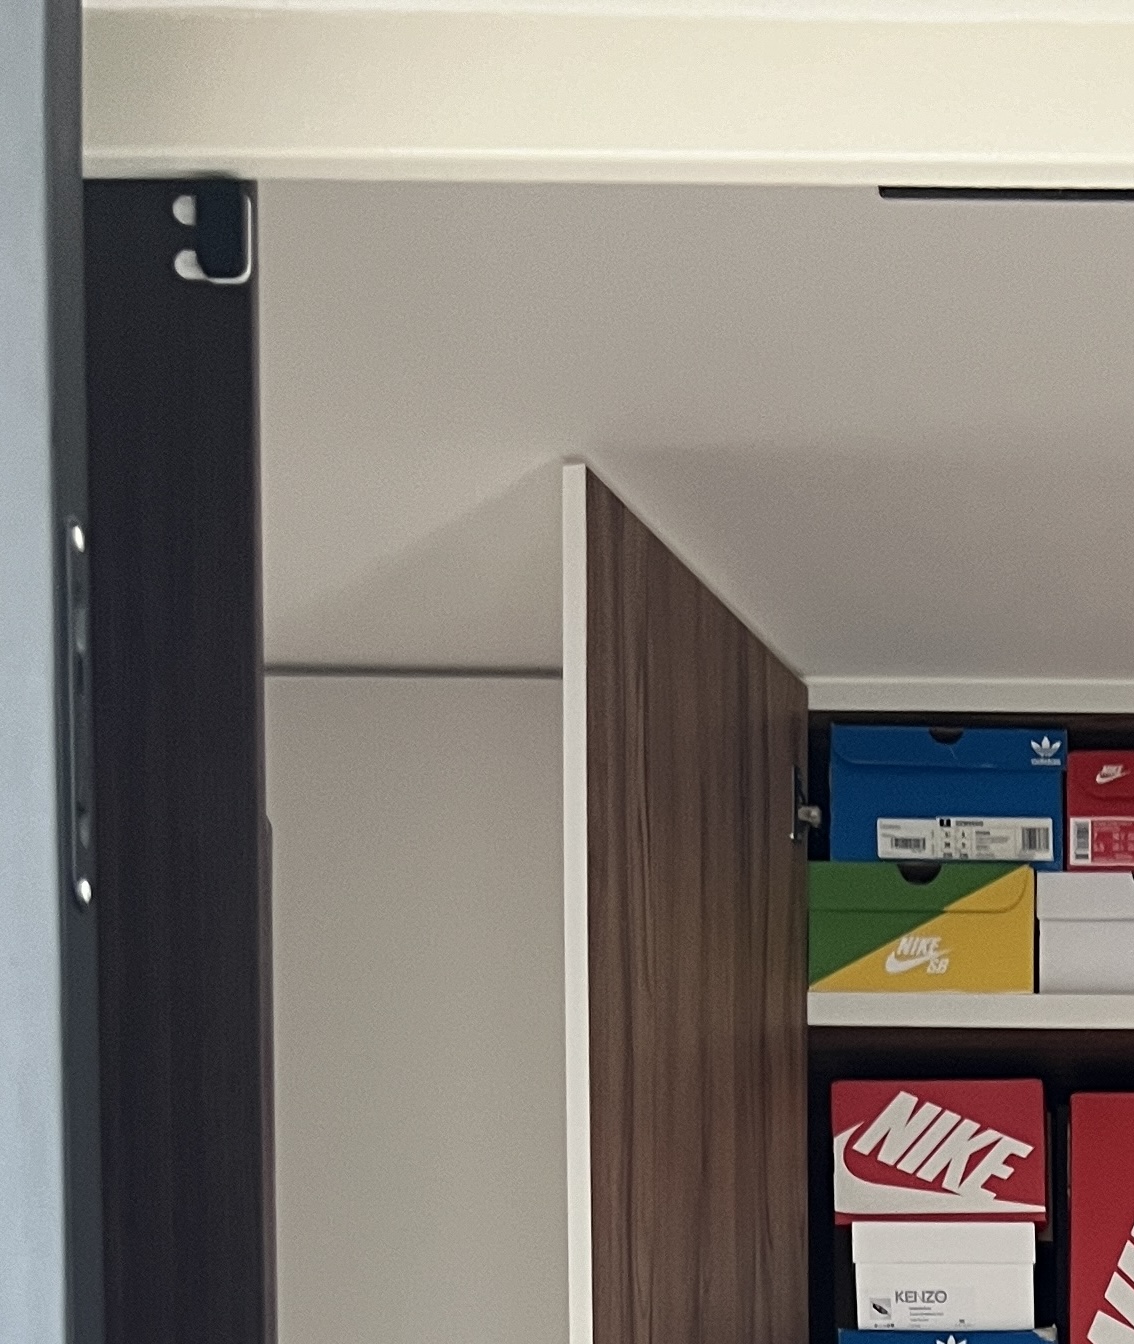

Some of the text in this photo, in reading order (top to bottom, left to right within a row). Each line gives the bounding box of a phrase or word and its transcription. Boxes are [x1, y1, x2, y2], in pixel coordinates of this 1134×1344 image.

[896, 936, 942, 959] NIKE
[852, 1091, 1034, 1200] NIKE
[894, 1290, 948, 1304] KENZO
